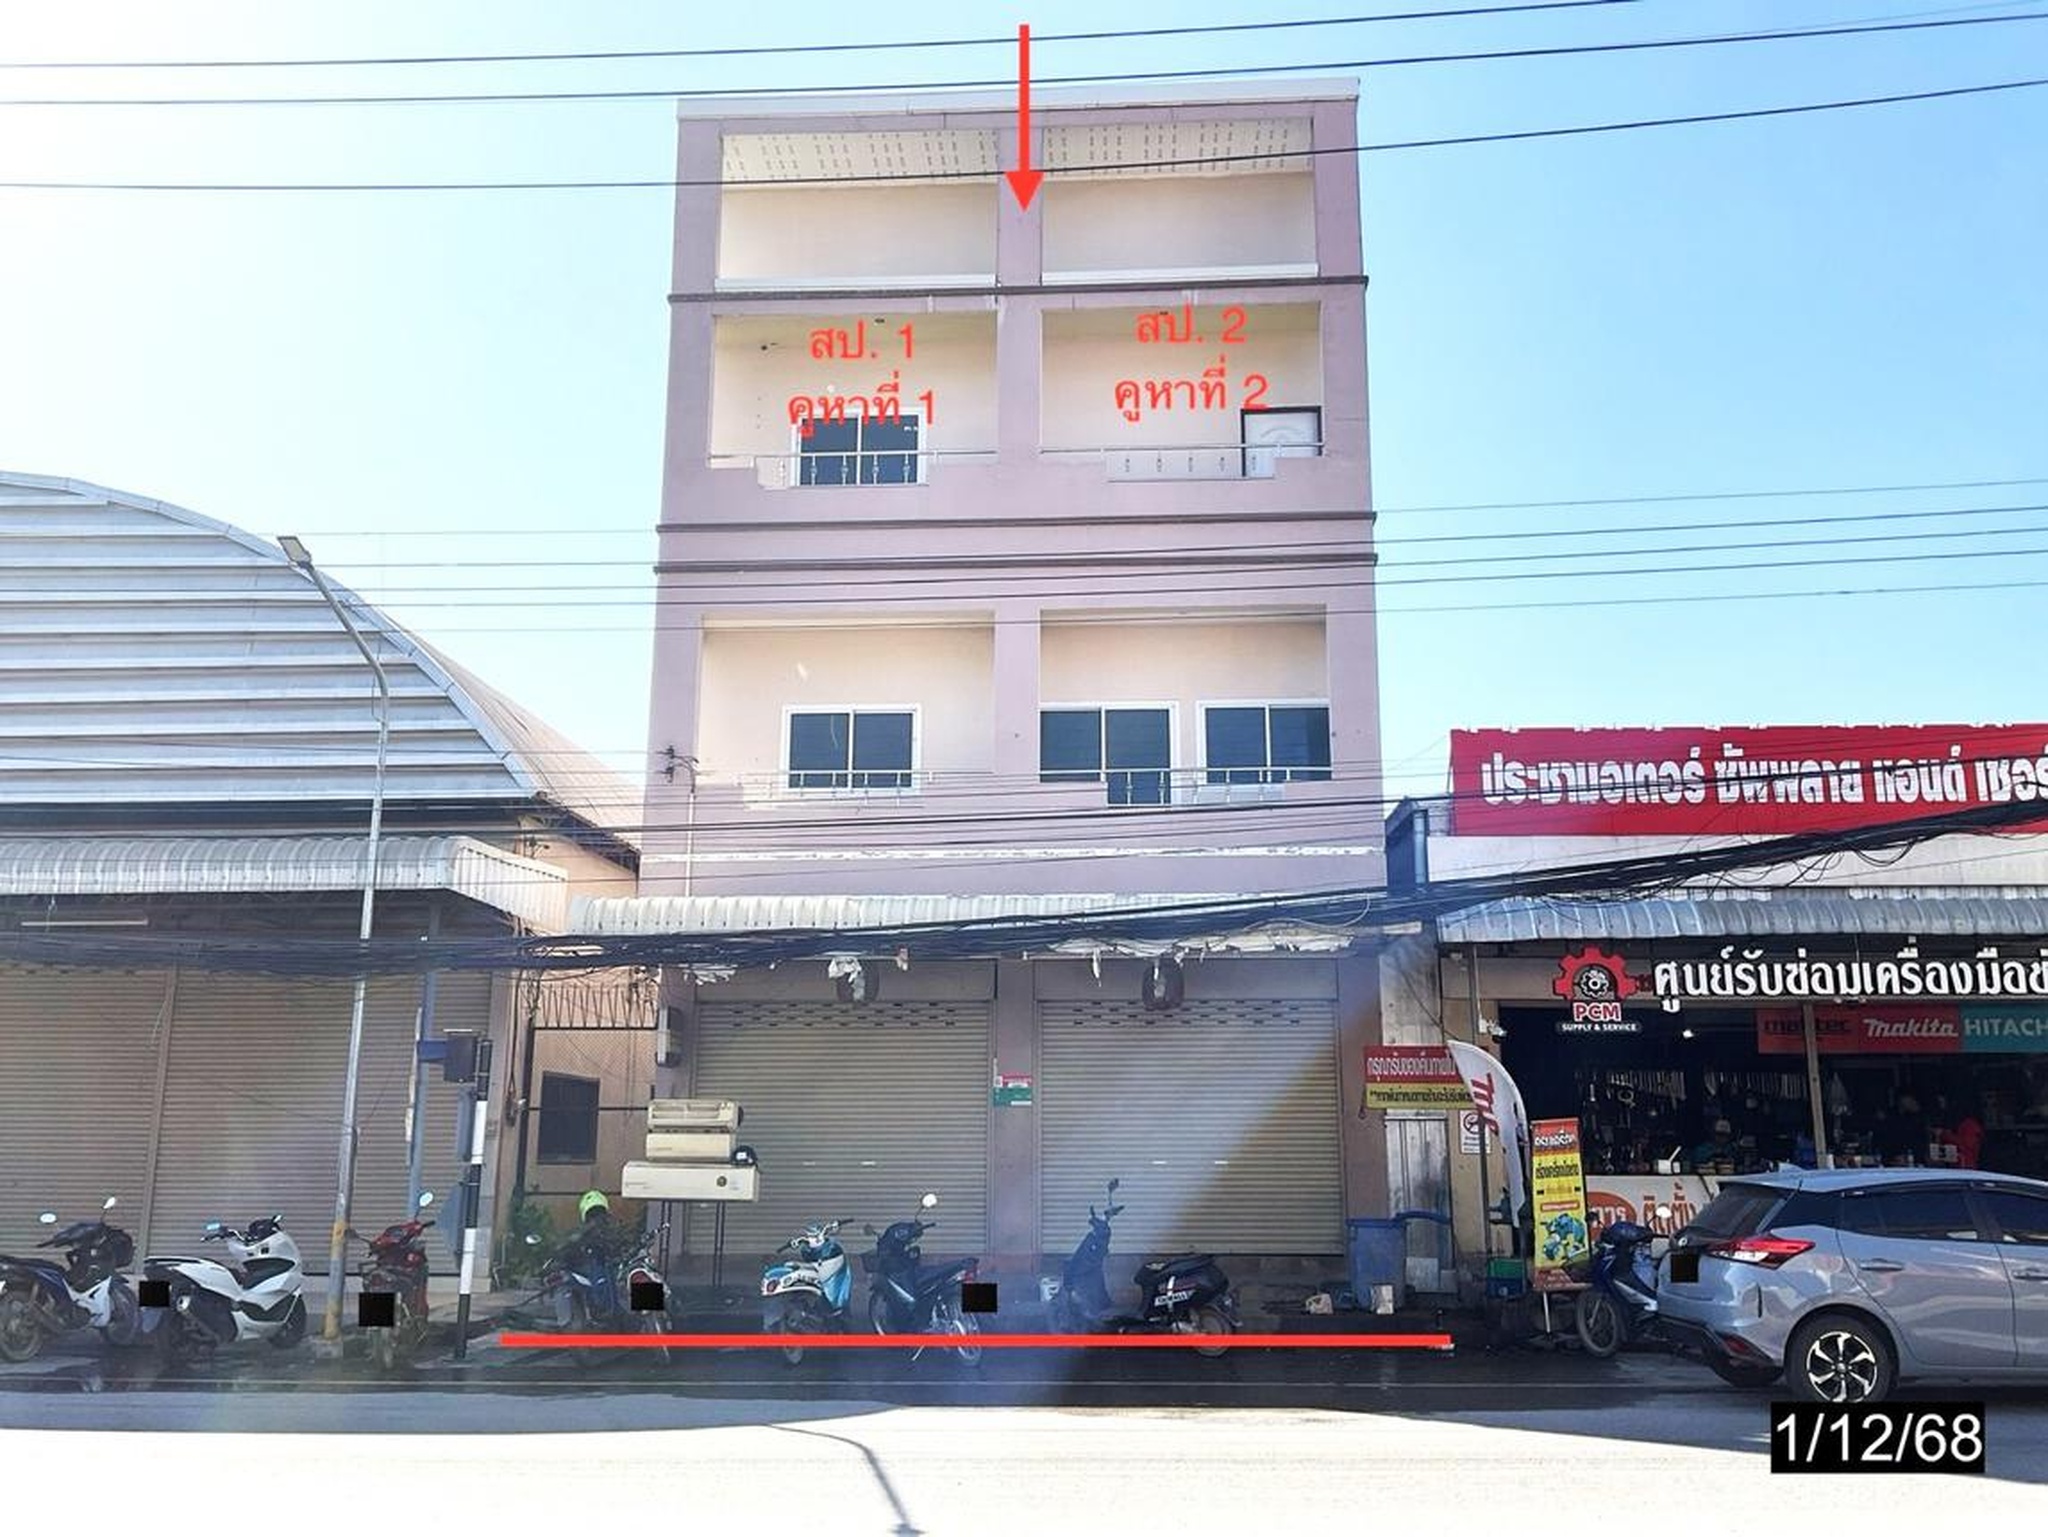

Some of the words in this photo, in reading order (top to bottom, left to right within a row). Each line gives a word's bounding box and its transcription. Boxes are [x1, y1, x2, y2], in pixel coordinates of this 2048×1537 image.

[1573, 1002, 1622, 1021] PCM
[1562, 1023, 1592, 1032] SUPPLY
[1602, 1023, 1637, 1032] SERVICE
